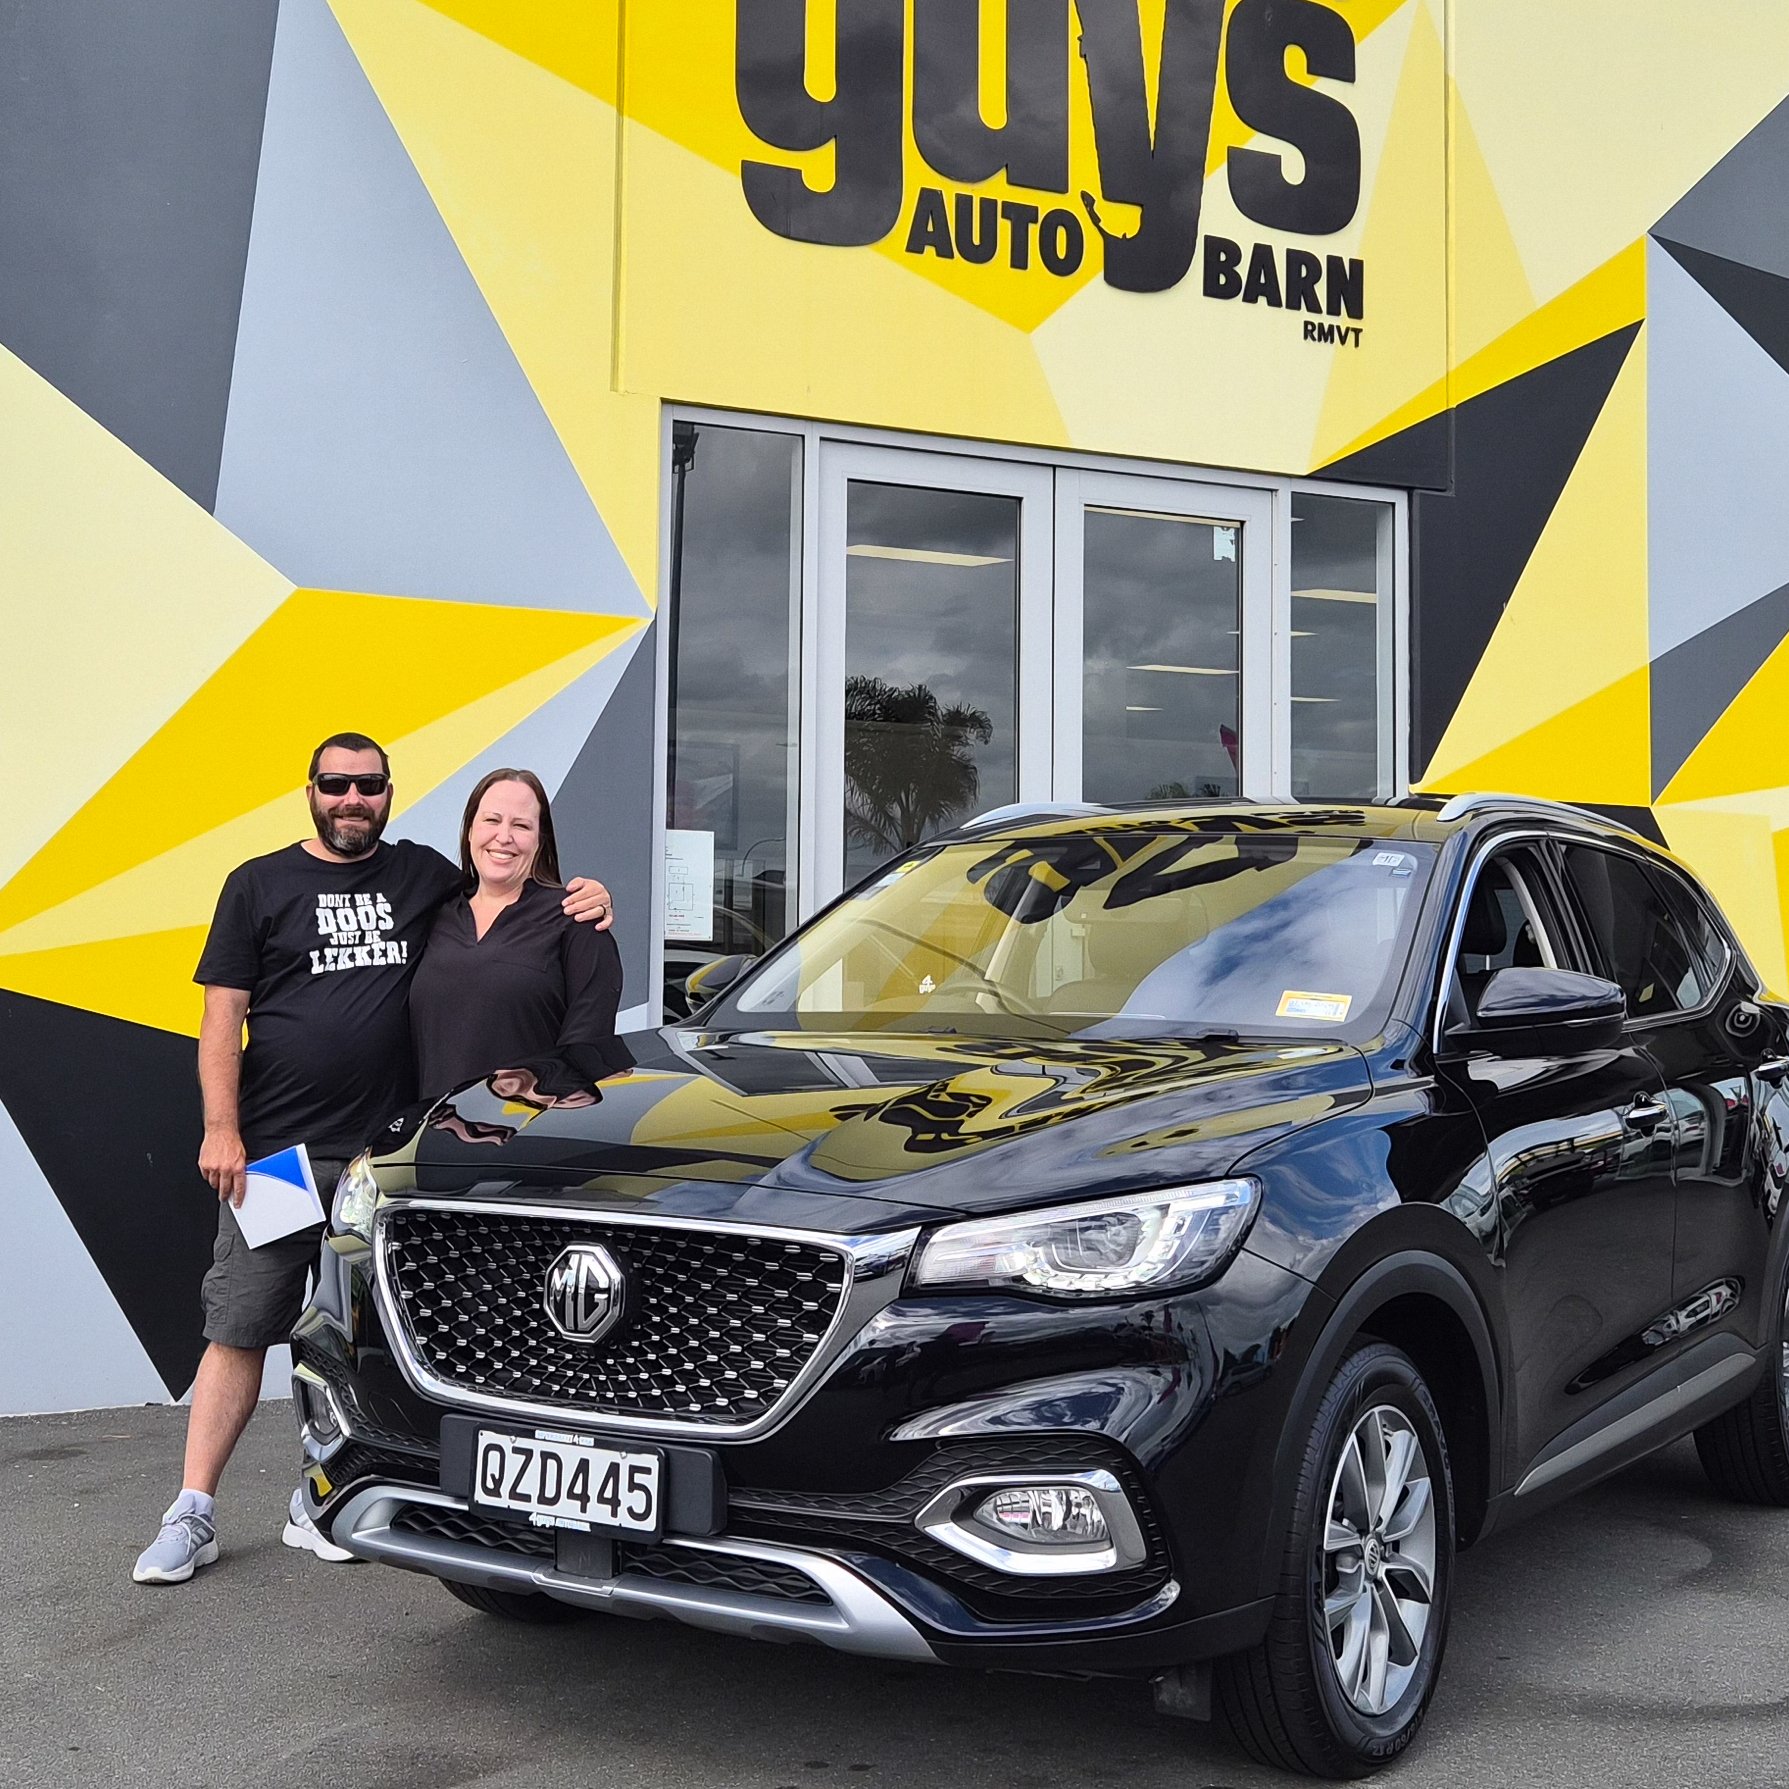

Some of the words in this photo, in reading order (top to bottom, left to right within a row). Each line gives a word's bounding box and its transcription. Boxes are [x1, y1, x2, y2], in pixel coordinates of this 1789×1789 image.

[735, 0, 1361, 293] guys
[905, 187, 1085, 277] AUTO
[1202, 234, 1364, 320] BARN
[1302, 320, 1363, 349] RMVT
[354, 893, 373, 906] BE
[376, 892, 387, 904] A
[315, 902, 394, 935] DOOS
[329, 931, 361, 945] JUST
[364, 930, 381, 944] BE
[309, 940, 408, 975] LEKKER!
[549, 1251, 611, 1332] MG
[480, 1442, 653, 1522] QZD445
